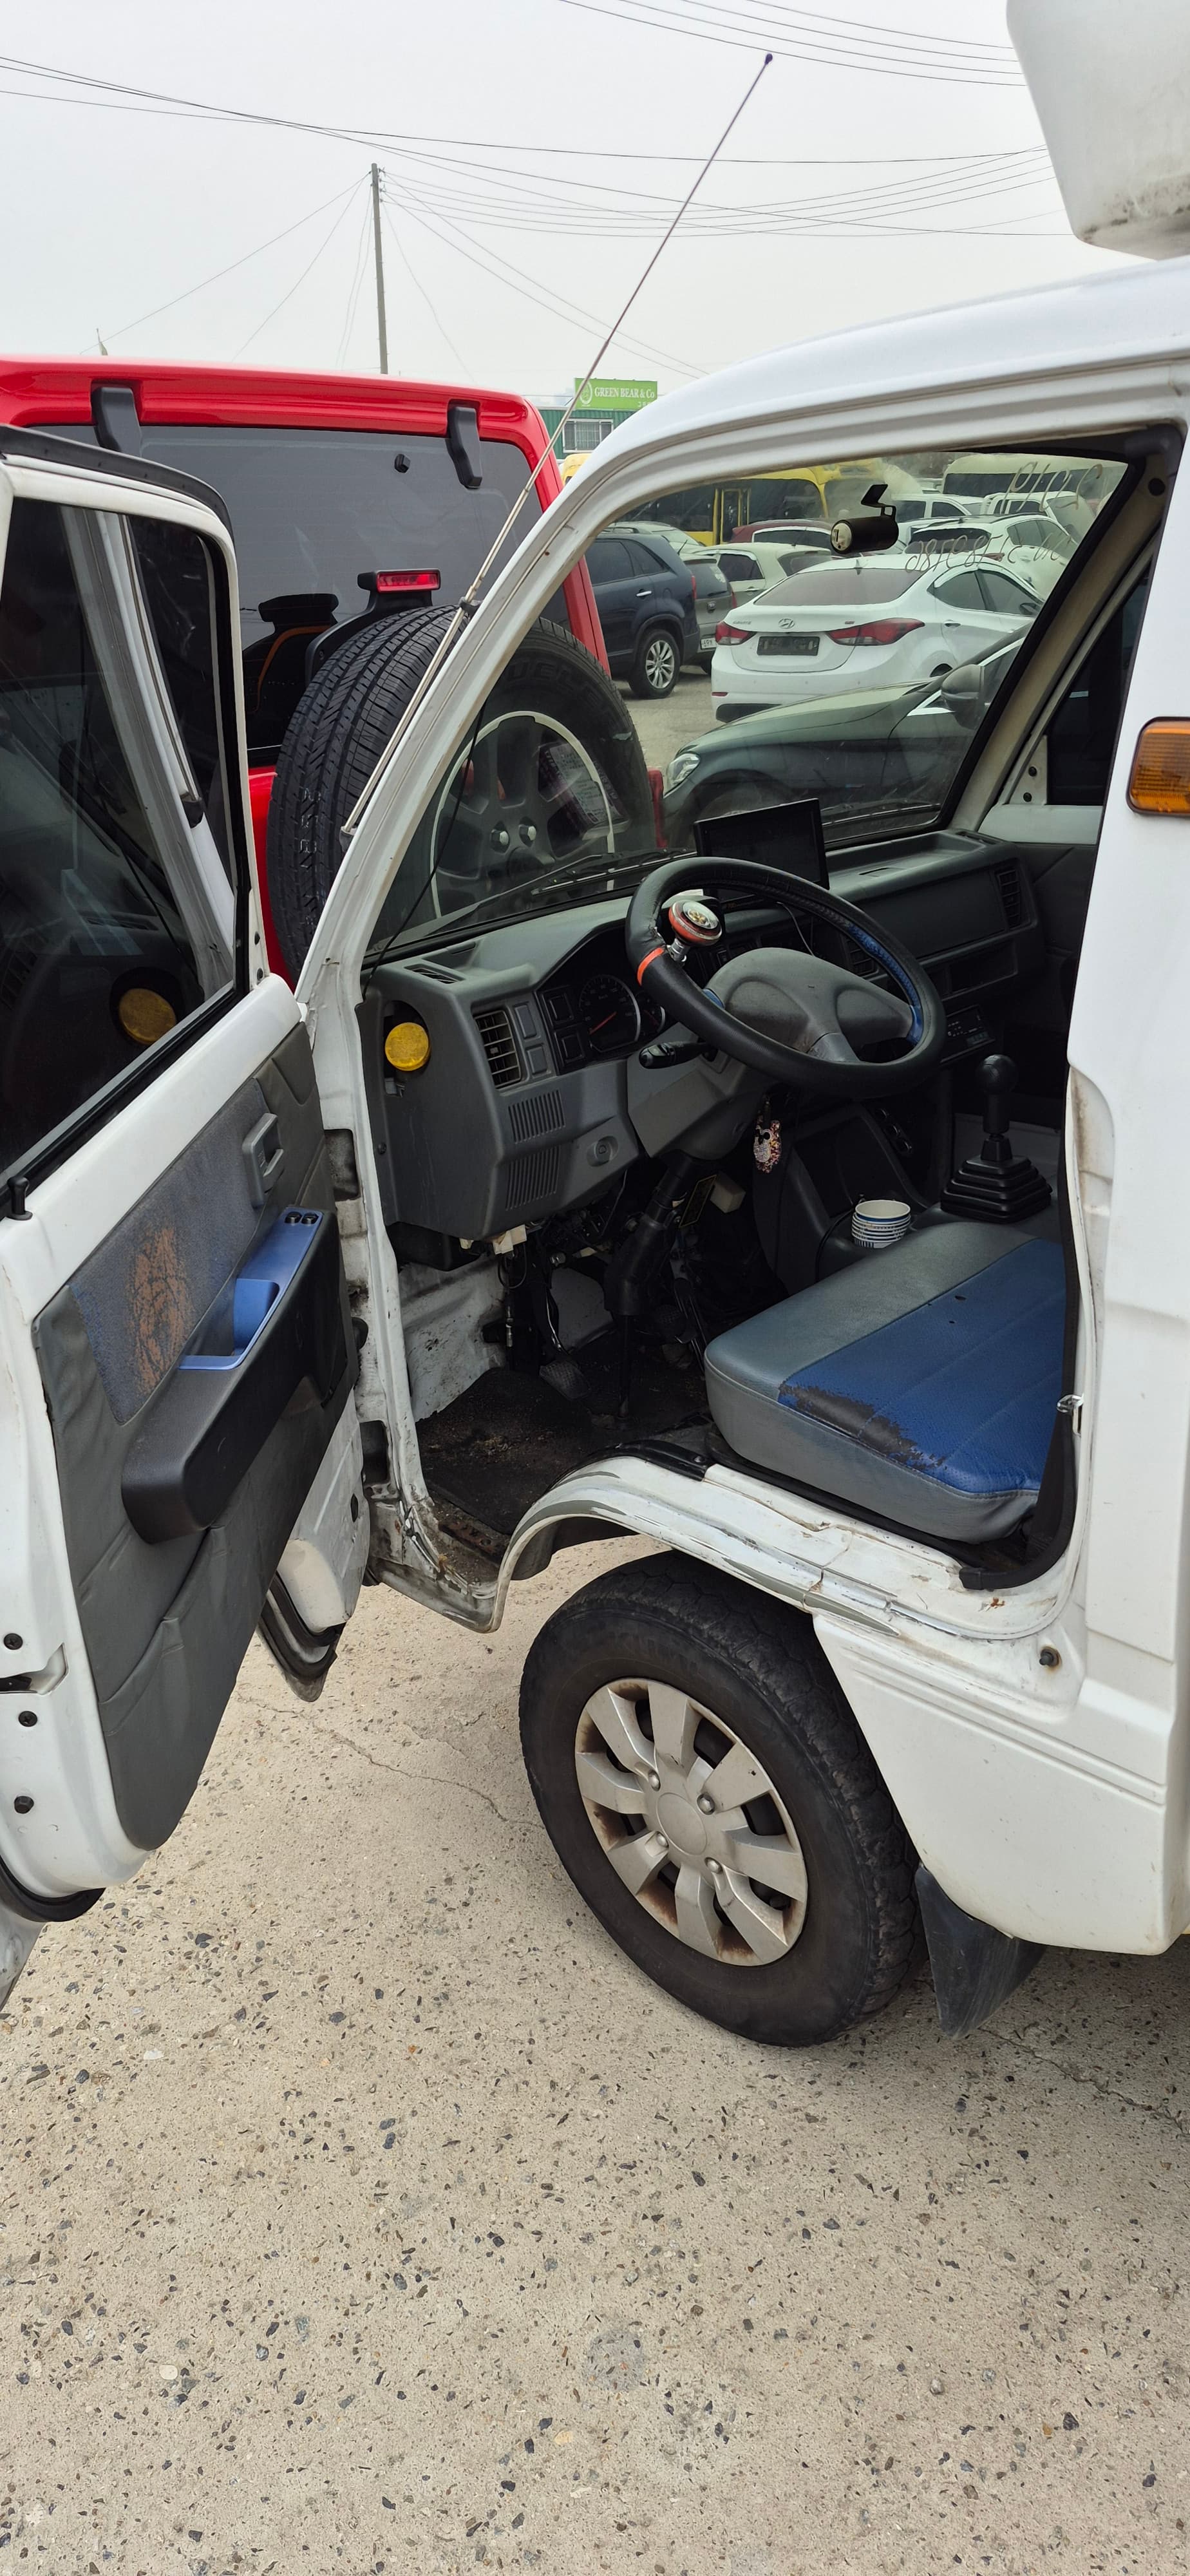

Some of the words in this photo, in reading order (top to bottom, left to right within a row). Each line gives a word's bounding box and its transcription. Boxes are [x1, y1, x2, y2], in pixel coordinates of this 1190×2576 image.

[595, 387, 619, 397] GREEN
[620, 388, 639, 398] BEAR
[639, 390, 646, 398] &
[646, 388, 655, 398] Co
